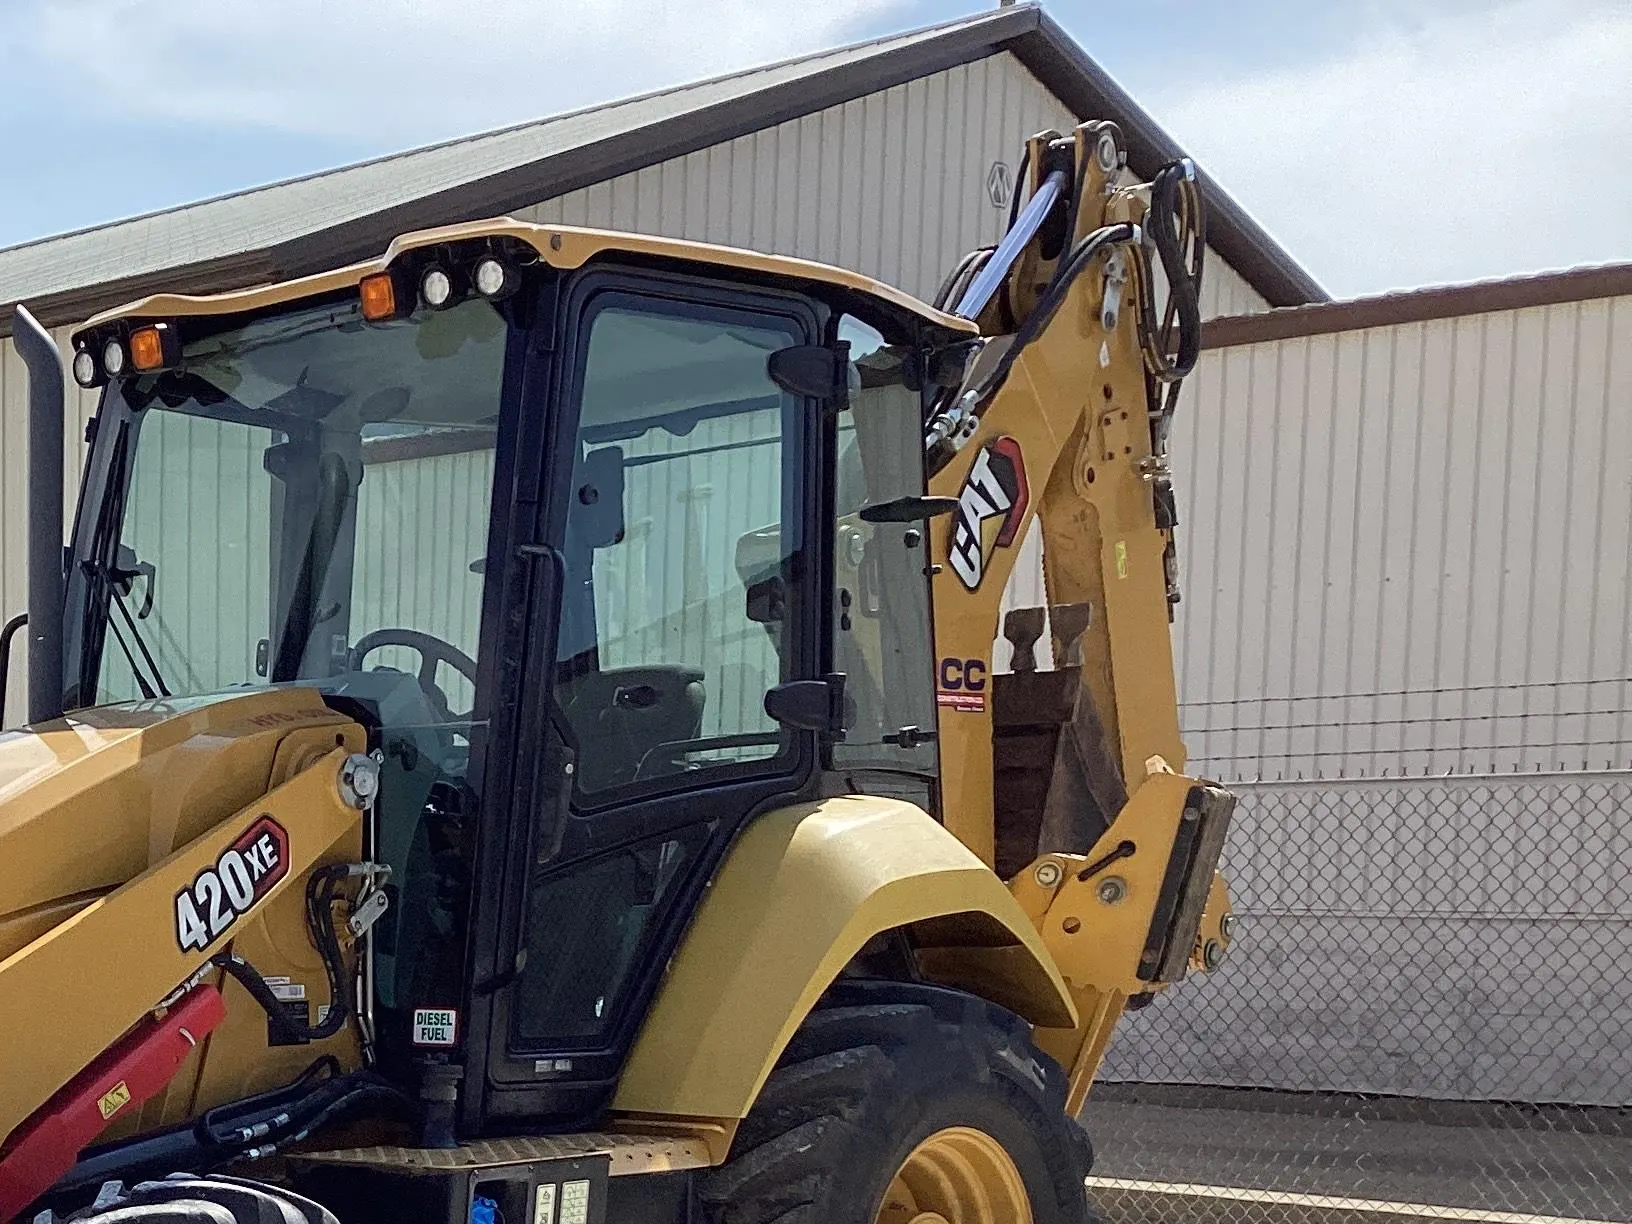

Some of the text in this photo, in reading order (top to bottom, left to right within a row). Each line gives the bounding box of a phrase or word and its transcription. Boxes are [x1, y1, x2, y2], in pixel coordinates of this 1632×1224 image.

[949, 447, 1012, 588] CAT
[416, 1012, 453, 1026] DIESEL
[421, 1027, 447, 1041] FUEL
